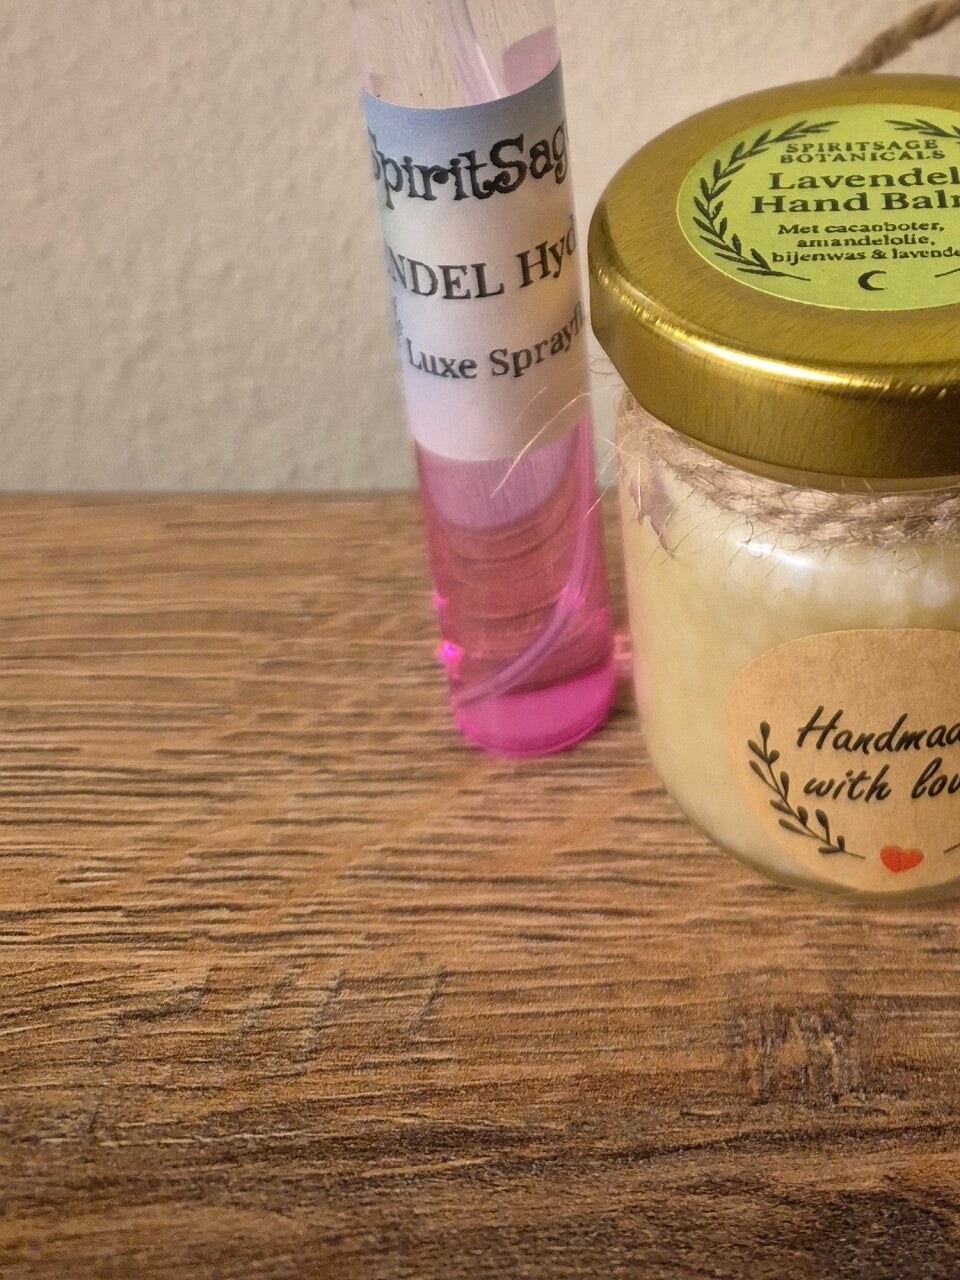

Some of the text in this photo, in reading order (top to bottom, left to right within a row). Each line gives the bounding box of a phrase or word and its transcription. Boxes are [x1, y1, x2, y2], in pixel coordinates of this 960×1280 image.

[785, 138, 939, 154] SPIRITSAGE
[779, 150, 946, 164] BOTANICALS
[750, 192, 870, 214] Hand
[778, 221, 945, 235] Met cacaoboter,
[797, 234, 936, 248] amandelolie,
[771, 251, 866, 266] bijenwas
[871, 248, 888, 260] &
[406, 338, 477, 379] Luxe
[803, 764, 892, 802] with
